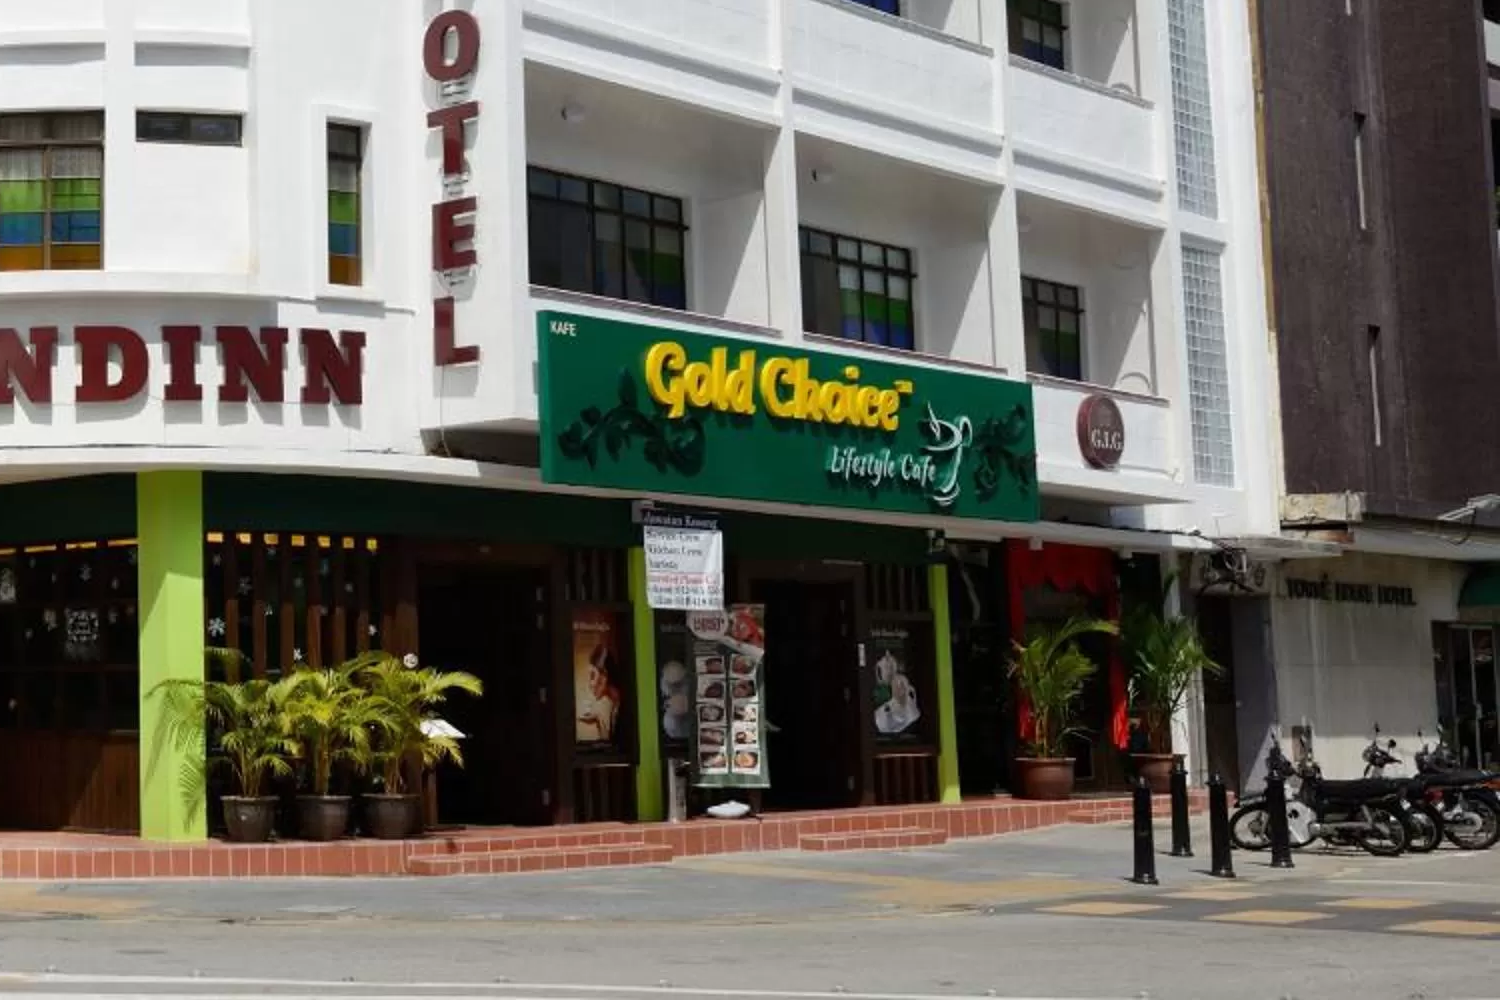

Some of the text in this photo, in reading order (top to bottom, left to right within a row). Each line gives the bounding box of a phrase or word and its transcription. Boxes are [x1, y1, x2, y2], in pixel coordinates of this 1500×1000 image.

[550, 320, 577, 337] KAFE
[645, 341, 900, 431] Gold Choice
[831, 445, 936, 488] Lifestyle Cafe
